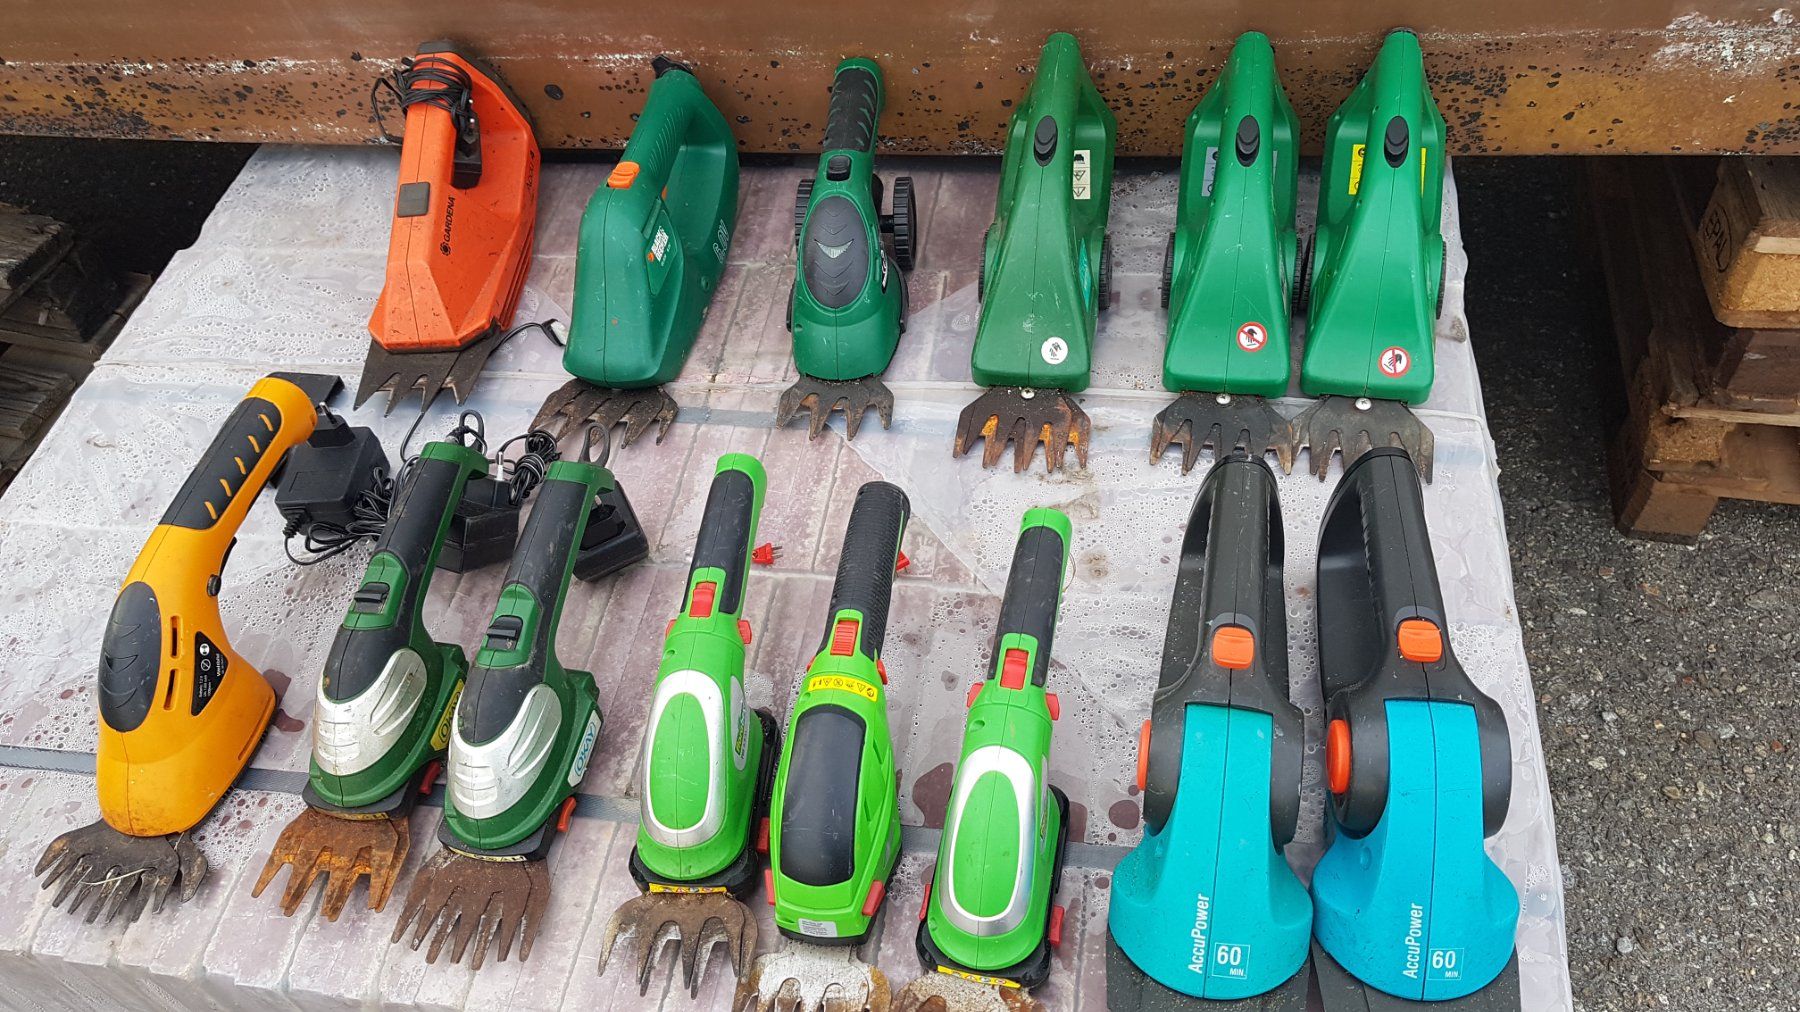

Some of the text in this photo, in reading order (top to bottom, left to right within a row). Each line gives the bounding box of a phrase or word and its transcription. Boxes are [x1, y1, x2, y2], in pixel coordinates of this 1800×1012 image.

[444, 196, 456, 243] GARDENA
[1705, 210, 1728, 269] EPAL
[575, 724, 596, 771] OKAY
[1188, 893, 1210, 974] AccuPower
[1217, 945, 1242, 965] 60
[1402, 902, 1424, 979] AccuPower
[1432, 950, 1456, 969] 60
